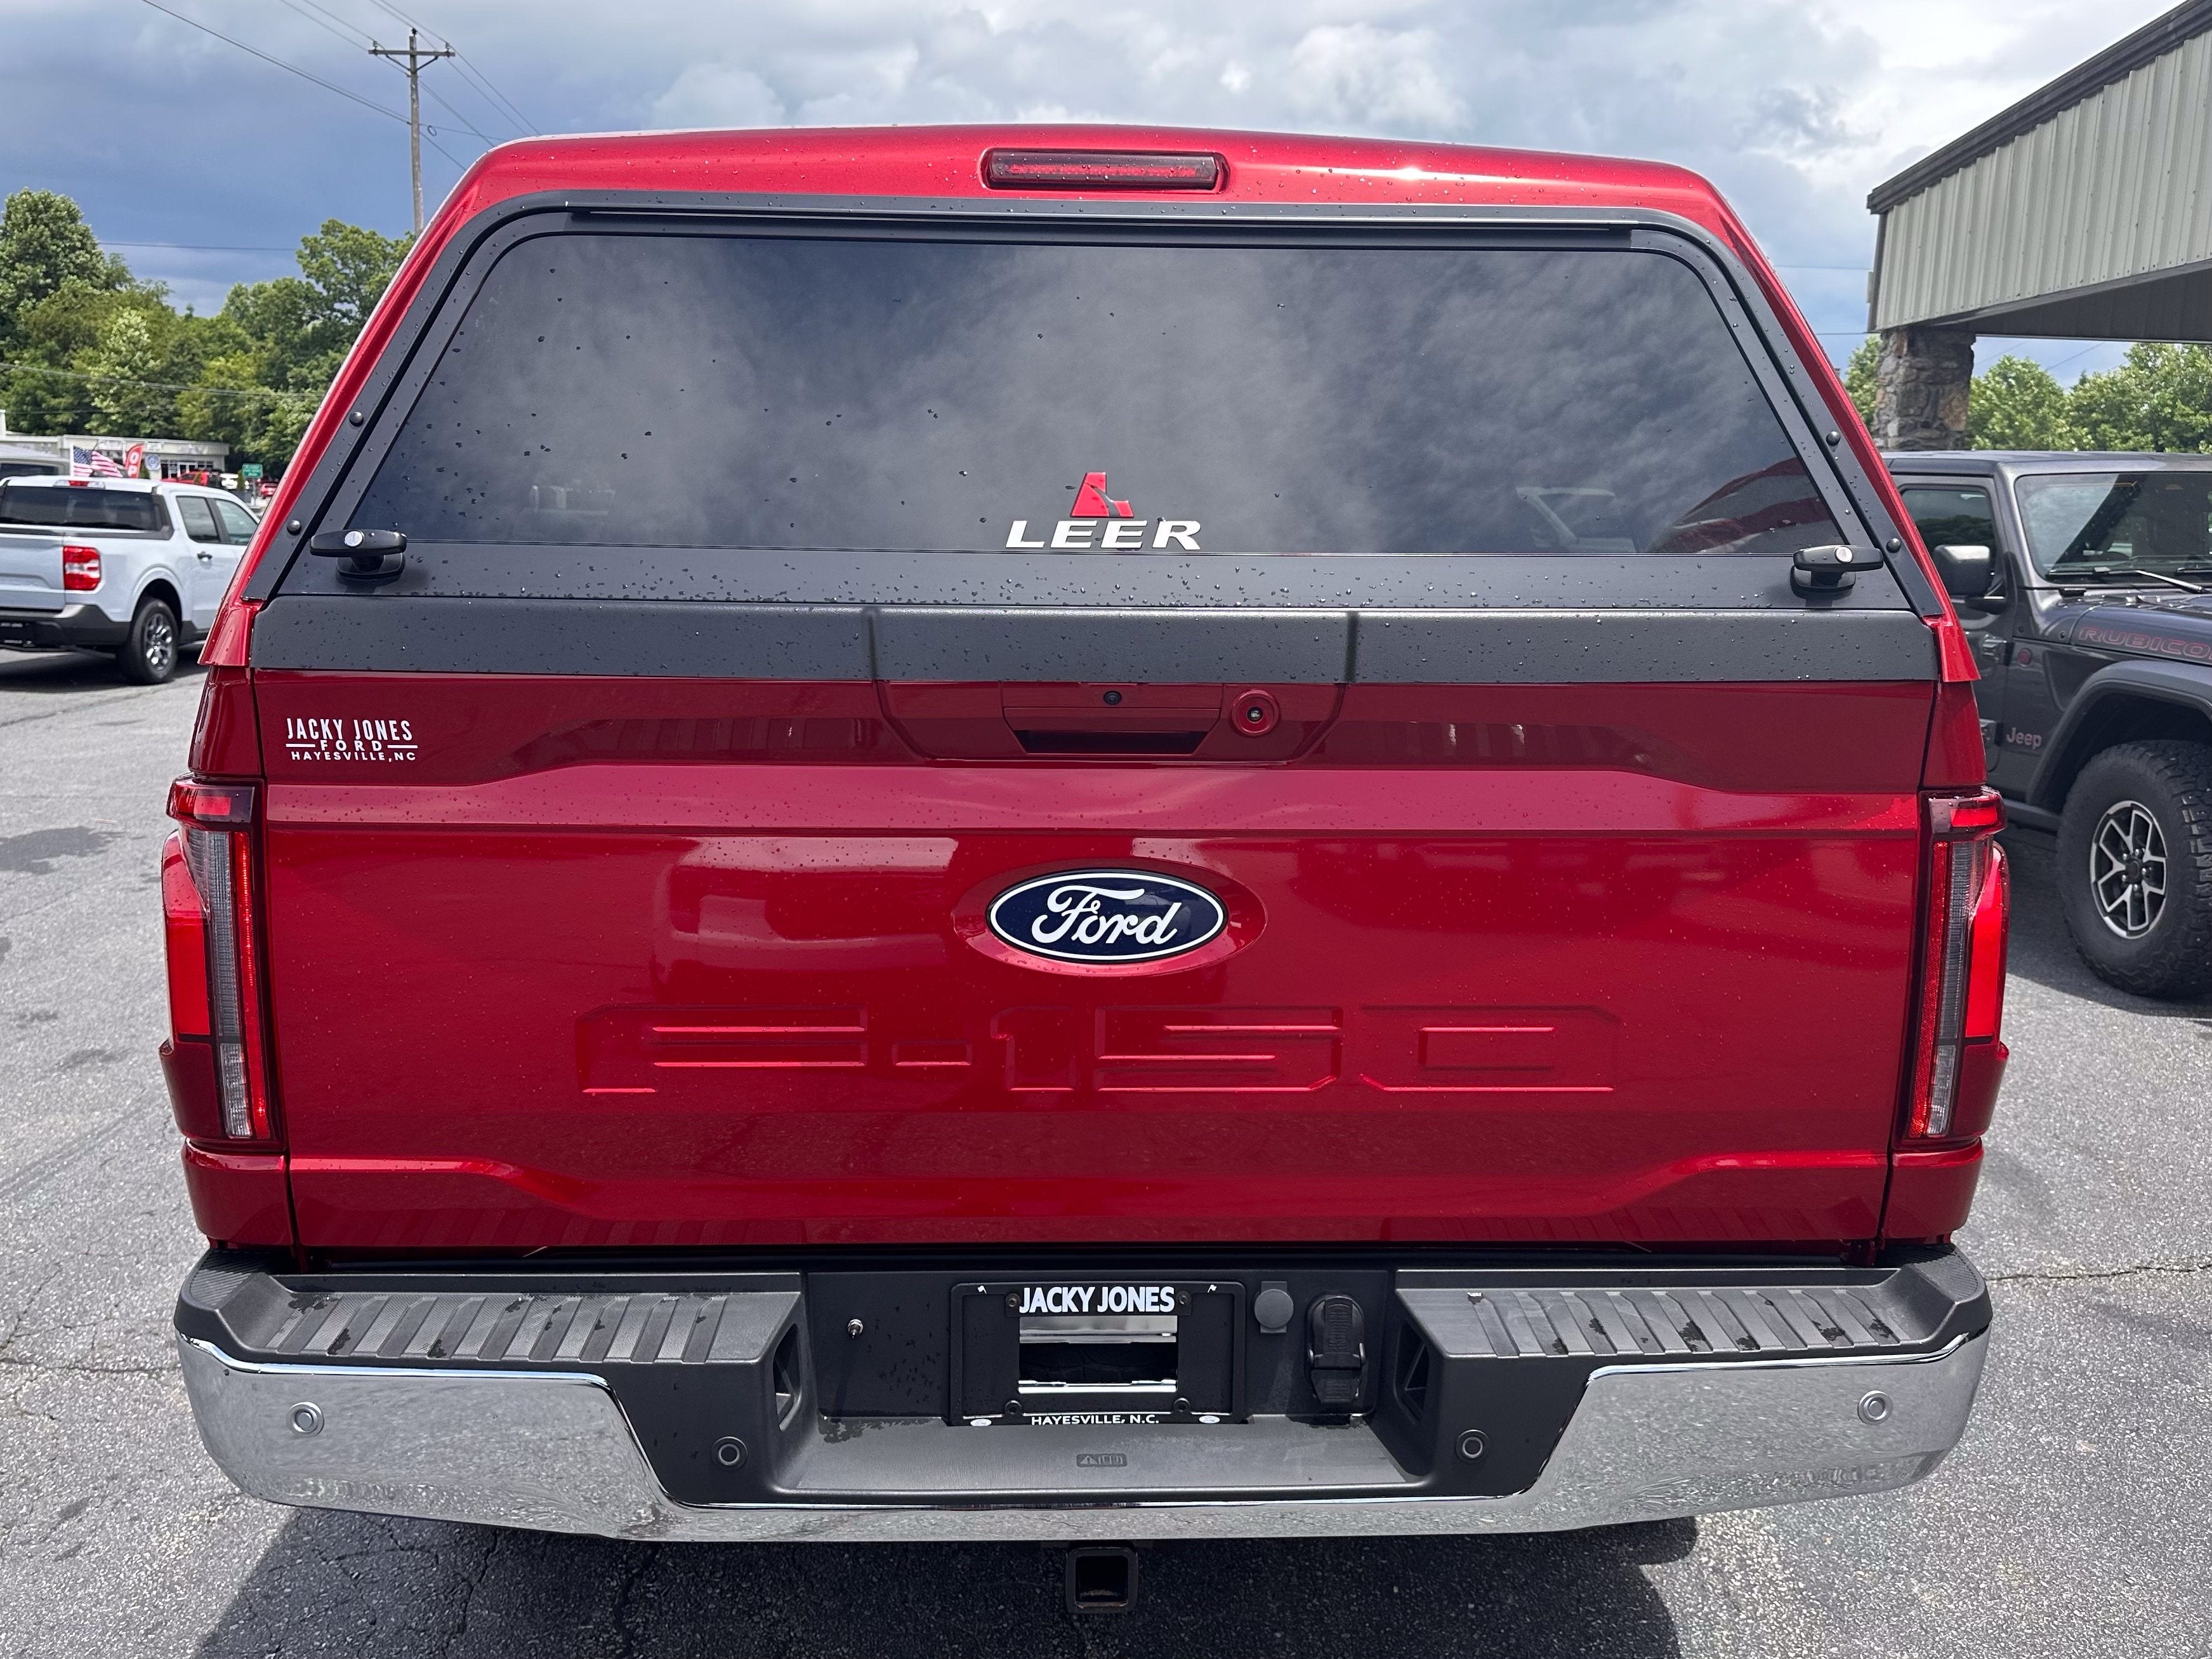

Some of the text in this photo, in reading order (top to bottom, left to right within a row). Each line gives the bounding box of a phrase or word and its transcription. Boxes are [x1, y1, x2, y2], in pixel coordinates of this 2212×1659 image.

[1005, 520, 1201, 550] LEER
[2078, 626, 2212, 660] RUBICO
[287, 718, 412, 741] JACKY JONES
[2006, 727, 2042, 750] Jeep
[320, 739, 382, 751] FORD
[1031, 885, 1183, 944] Ford
[576, 1005, 1616, 1093] F-150
[1019, 1286, 1175, 1313] JACKY JONES
[1031, 1414, 1159, 1425] HAYESVILLE, N.C.
